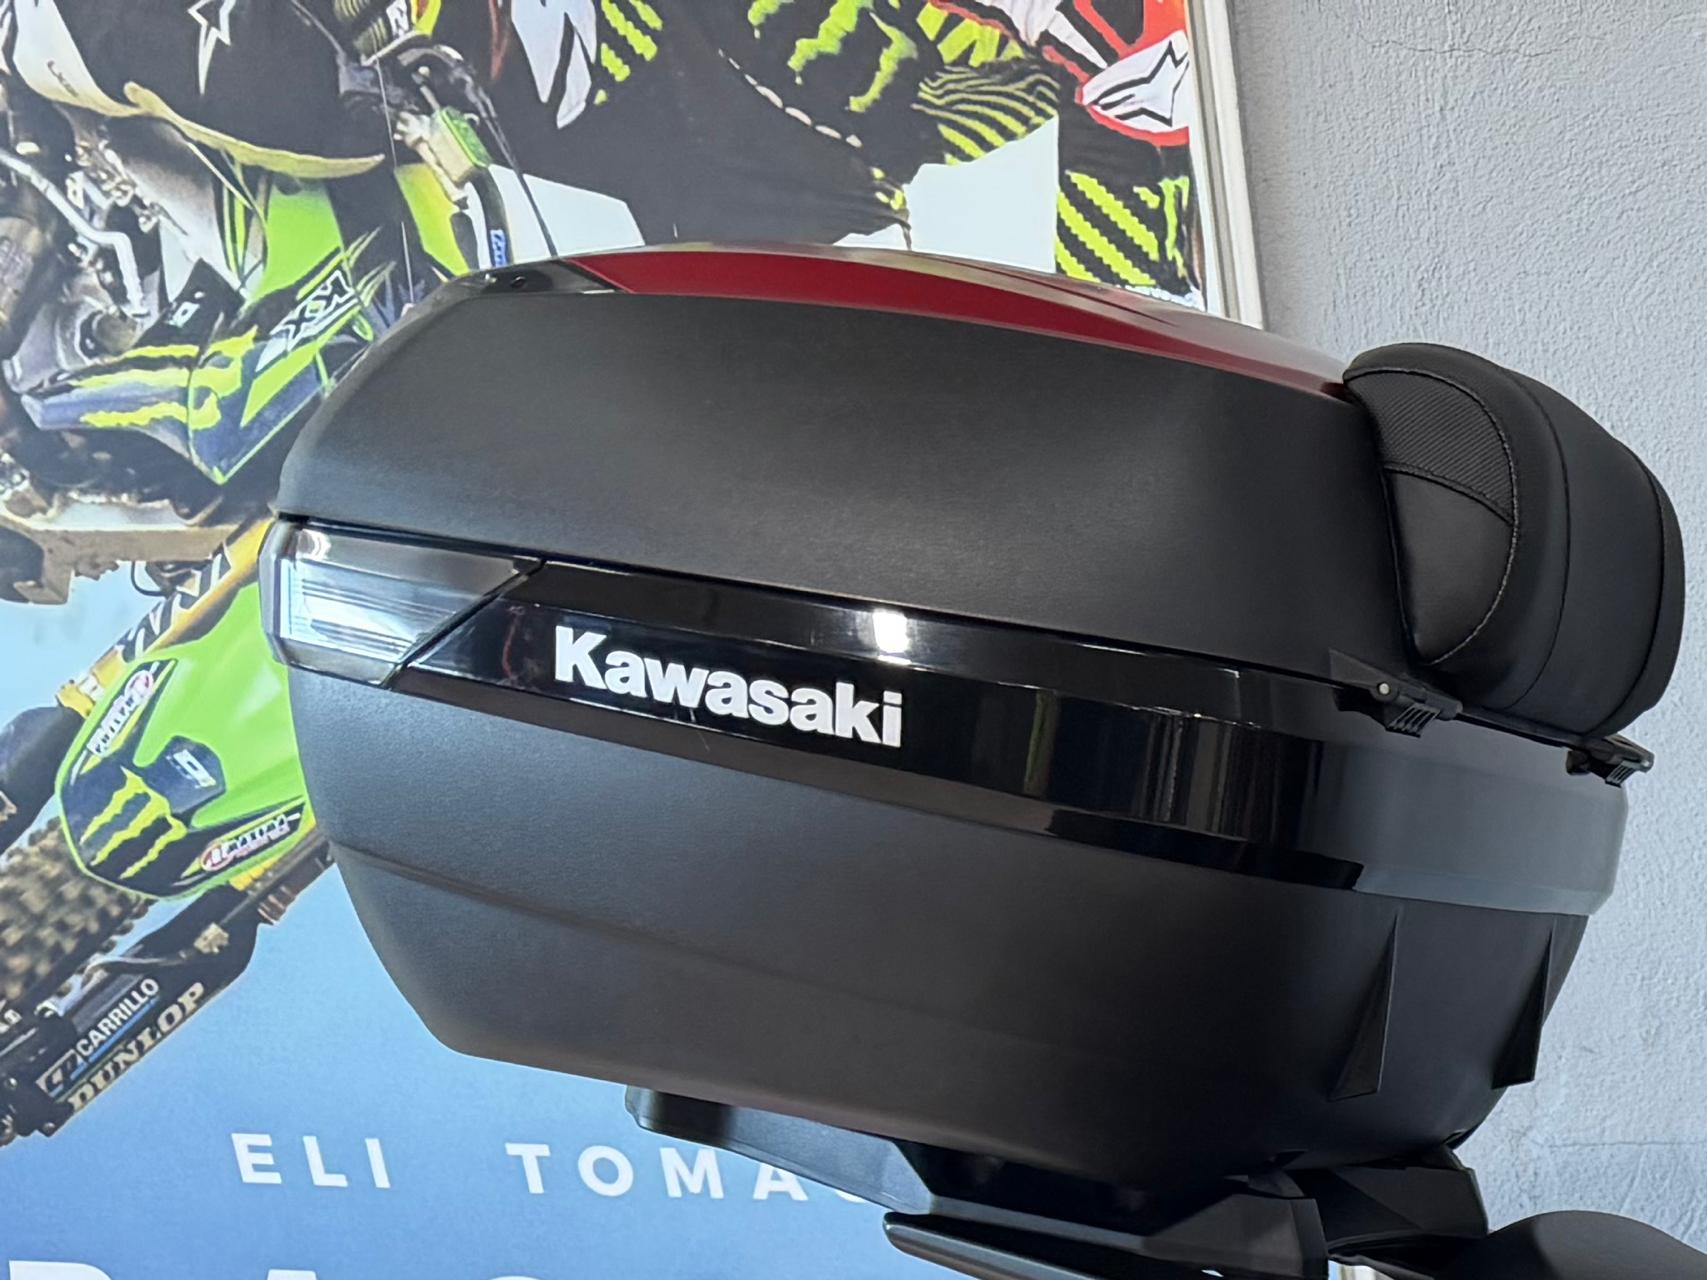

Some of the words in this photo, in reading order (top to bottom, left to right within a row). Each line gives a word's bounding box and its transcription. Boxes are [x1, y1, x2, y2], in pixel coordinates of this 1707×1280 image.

[554, 625, 902, 747] Kawasaki
[67, 982, 204, 1111] DUNLOP
[76, 978, 159, 1057] CARRILLO
[230, 1132, 392, 1189] ELI
[504, 1142, 867, 1203] TOMA
